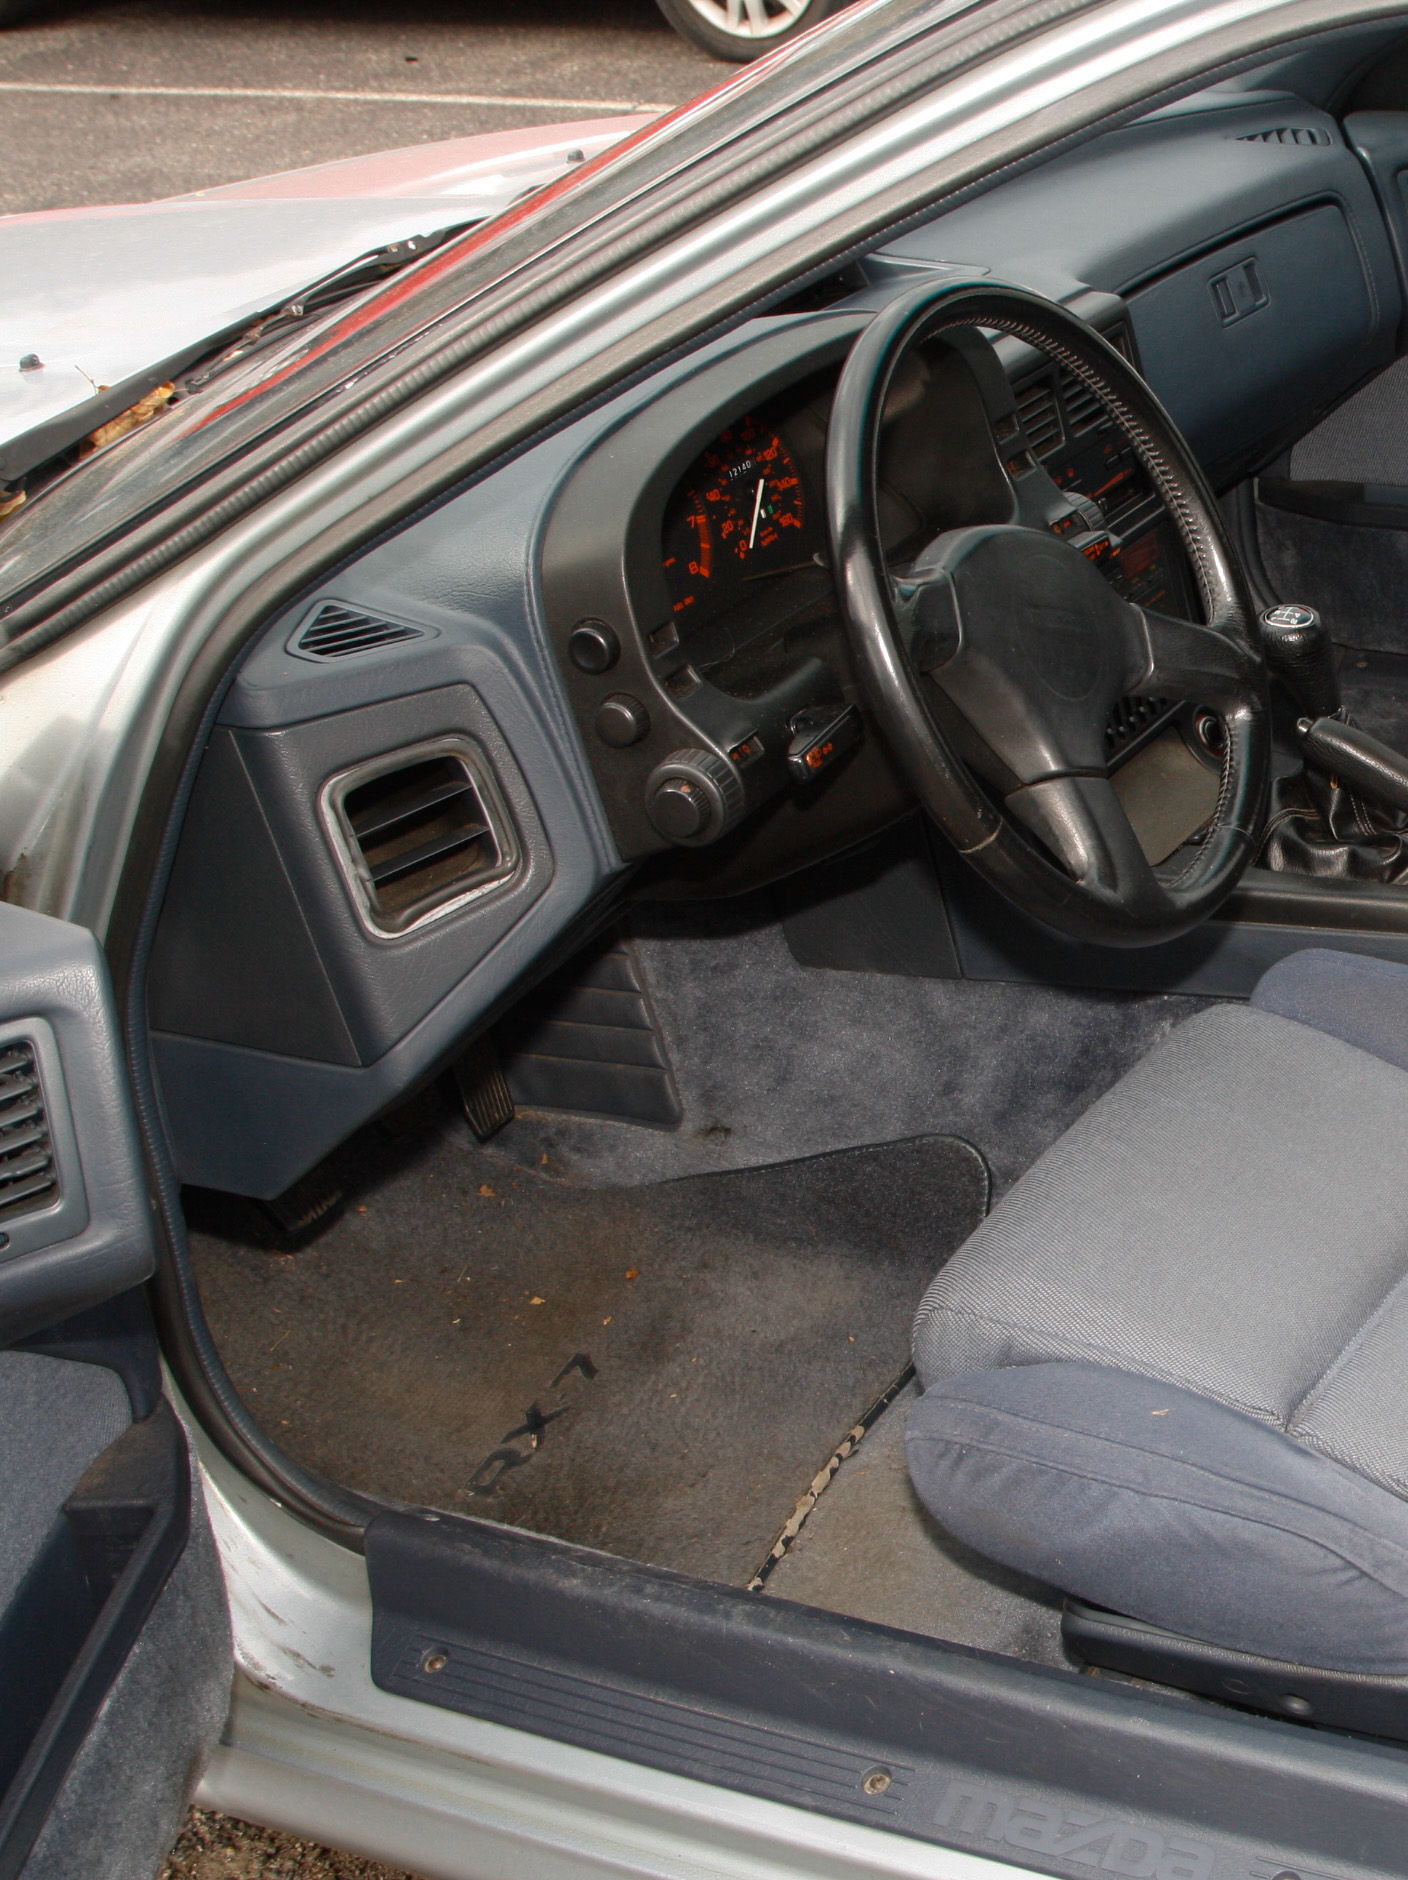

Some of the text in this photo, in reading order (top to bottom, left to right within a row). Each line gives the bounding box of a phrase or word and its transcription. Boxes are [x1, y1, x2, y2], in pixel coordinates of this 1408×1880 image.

[728, 460, 751, 478] 12140
[686, 515, 696, 528] 7
[739, 540, 748, 551] 0
[688, 560, 699, 575] 8
[932, 1780, 1216, 1880] mazda
